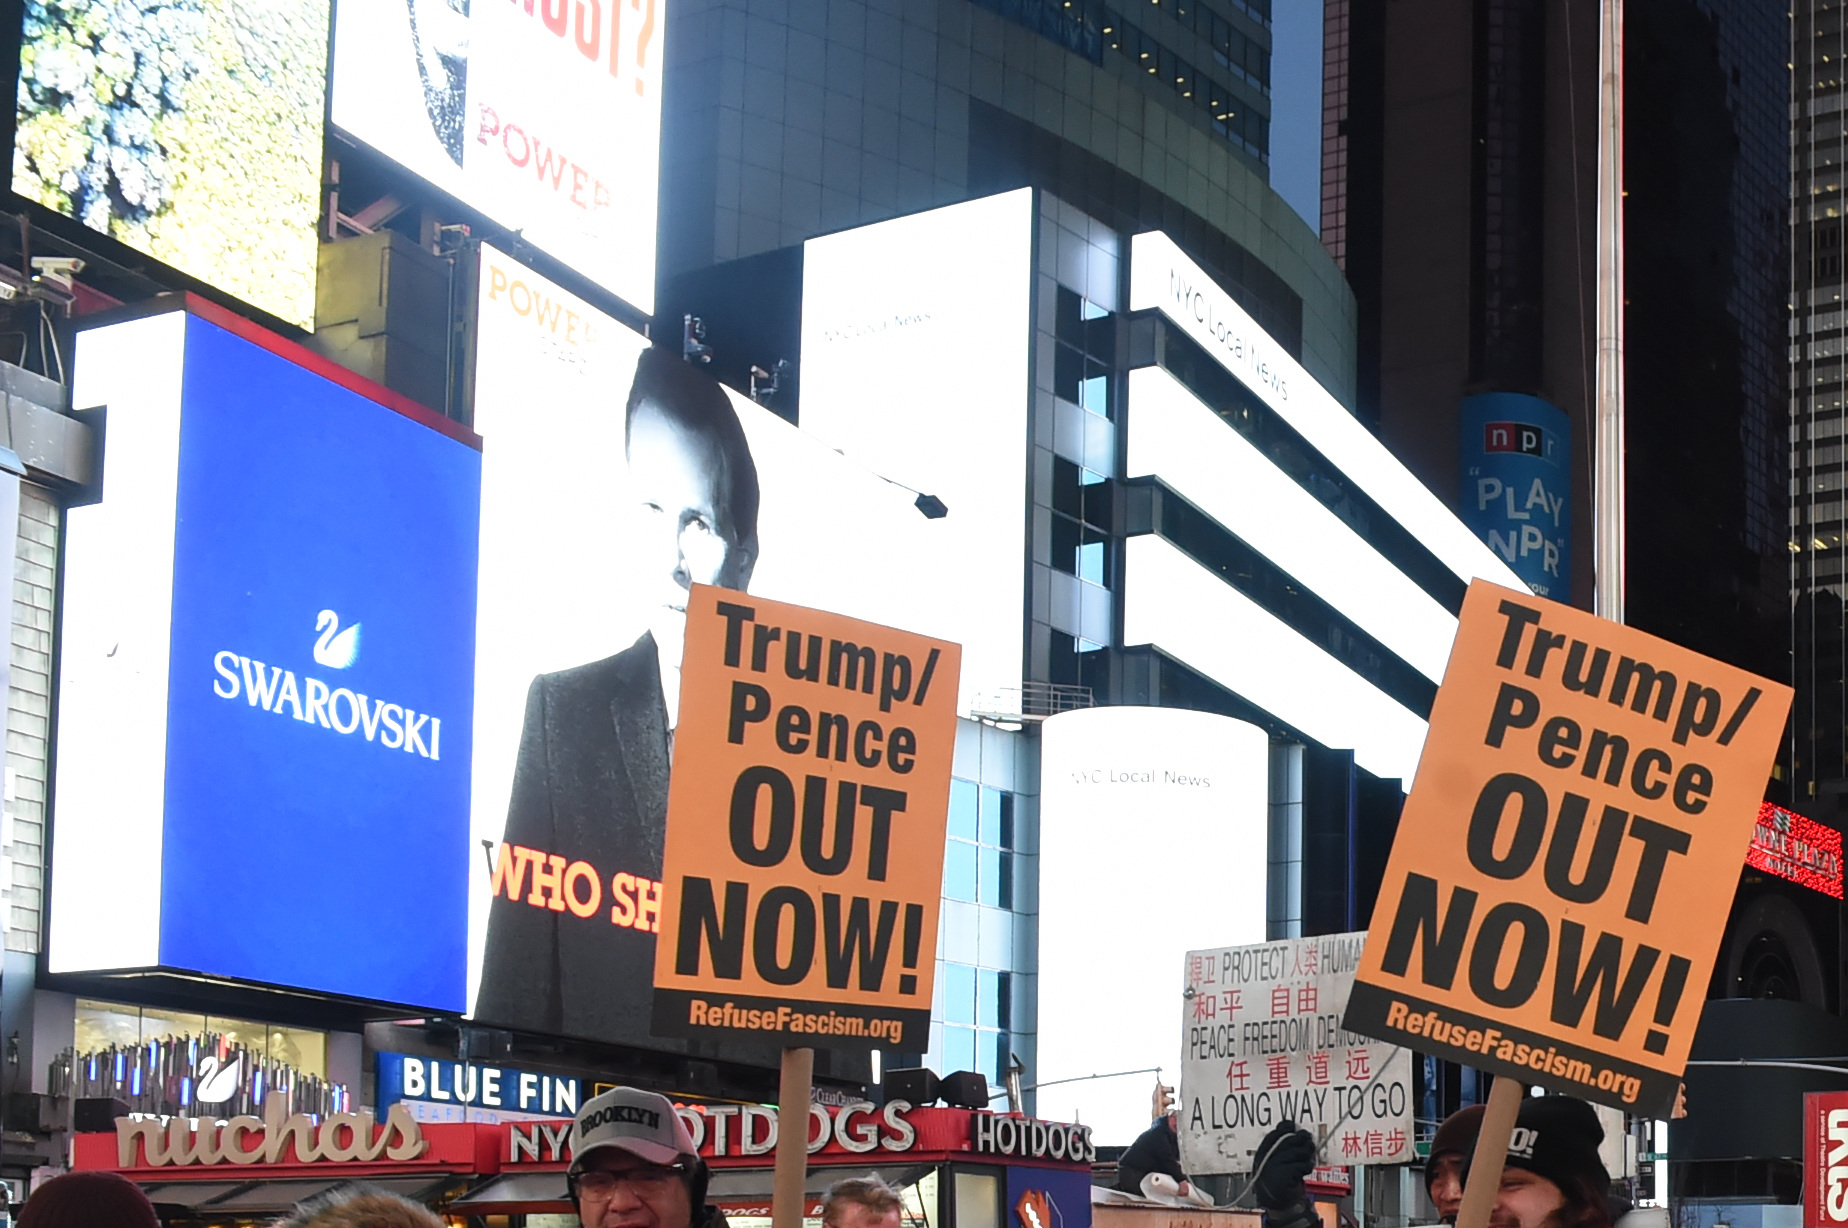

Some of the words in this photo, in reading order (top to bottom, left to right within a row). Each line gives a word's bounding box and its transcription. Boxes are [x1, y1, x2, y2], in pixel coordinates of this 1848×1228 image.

[1168, 267, 1206, 326] NYC
[1208, 310, 1248, 364] Local
[1250, 349, 1290, 402] News
[716, 600, 941, 707] Trump/
[1495, 598, 1762, 748] Trump/
[212, 650, 441, 761] SWAROVSKI
[726, 680, 918, 775] Pence
[1483, 681, 1714, 814] Pence
[728, 764, 907, 883] OUT
[1466, 771, 1693, 926] OUT
[481, 838, 600, 918] WHO
[674, 875, 925, 996] NOW!
[1221, 945, 1289, 986] PROTECT
[1290, 944, 1318, 977] 人类
[1320, 938, 1366, 975] HUMA
[1379, 869, 1692, 1057] NOW!
[688, 999, 903, 1044] RefuseFascism.org
[1192, 990, 1244, 1025] 和平
[1271, 981, 1319, 1018] 自由
[1190, 1024, 1236, 1061] PEACE
[1242, 1018, 1310, 1057] FREEDOM
[1384, 999, 1643, 1103] RefuseFascism.org
[402, 1056, 502, 1107] BLUE
[518, 1071, 577, 1115] FIN
[402, 1102, 499, 1125] EAFOOD
[1190, 1096, 1205, 1132] A
[1211, 1092, 1272, 1131] LONG
[1277, 1086, 1328, 1126] WAY
[1333, 1084, 1364, 1121] TO
[1370, 1081, 1406, 1119] GO
[510, 1123, 576, 1163] NY
[678, 1098, 916, 1162] OTDOGS
[579, 1105, 660, 1138] BROOKLYN
[977, 1111, 1097, 1163] HOTDOGS
[1341, 1127, 1407, 1159] 林信步
